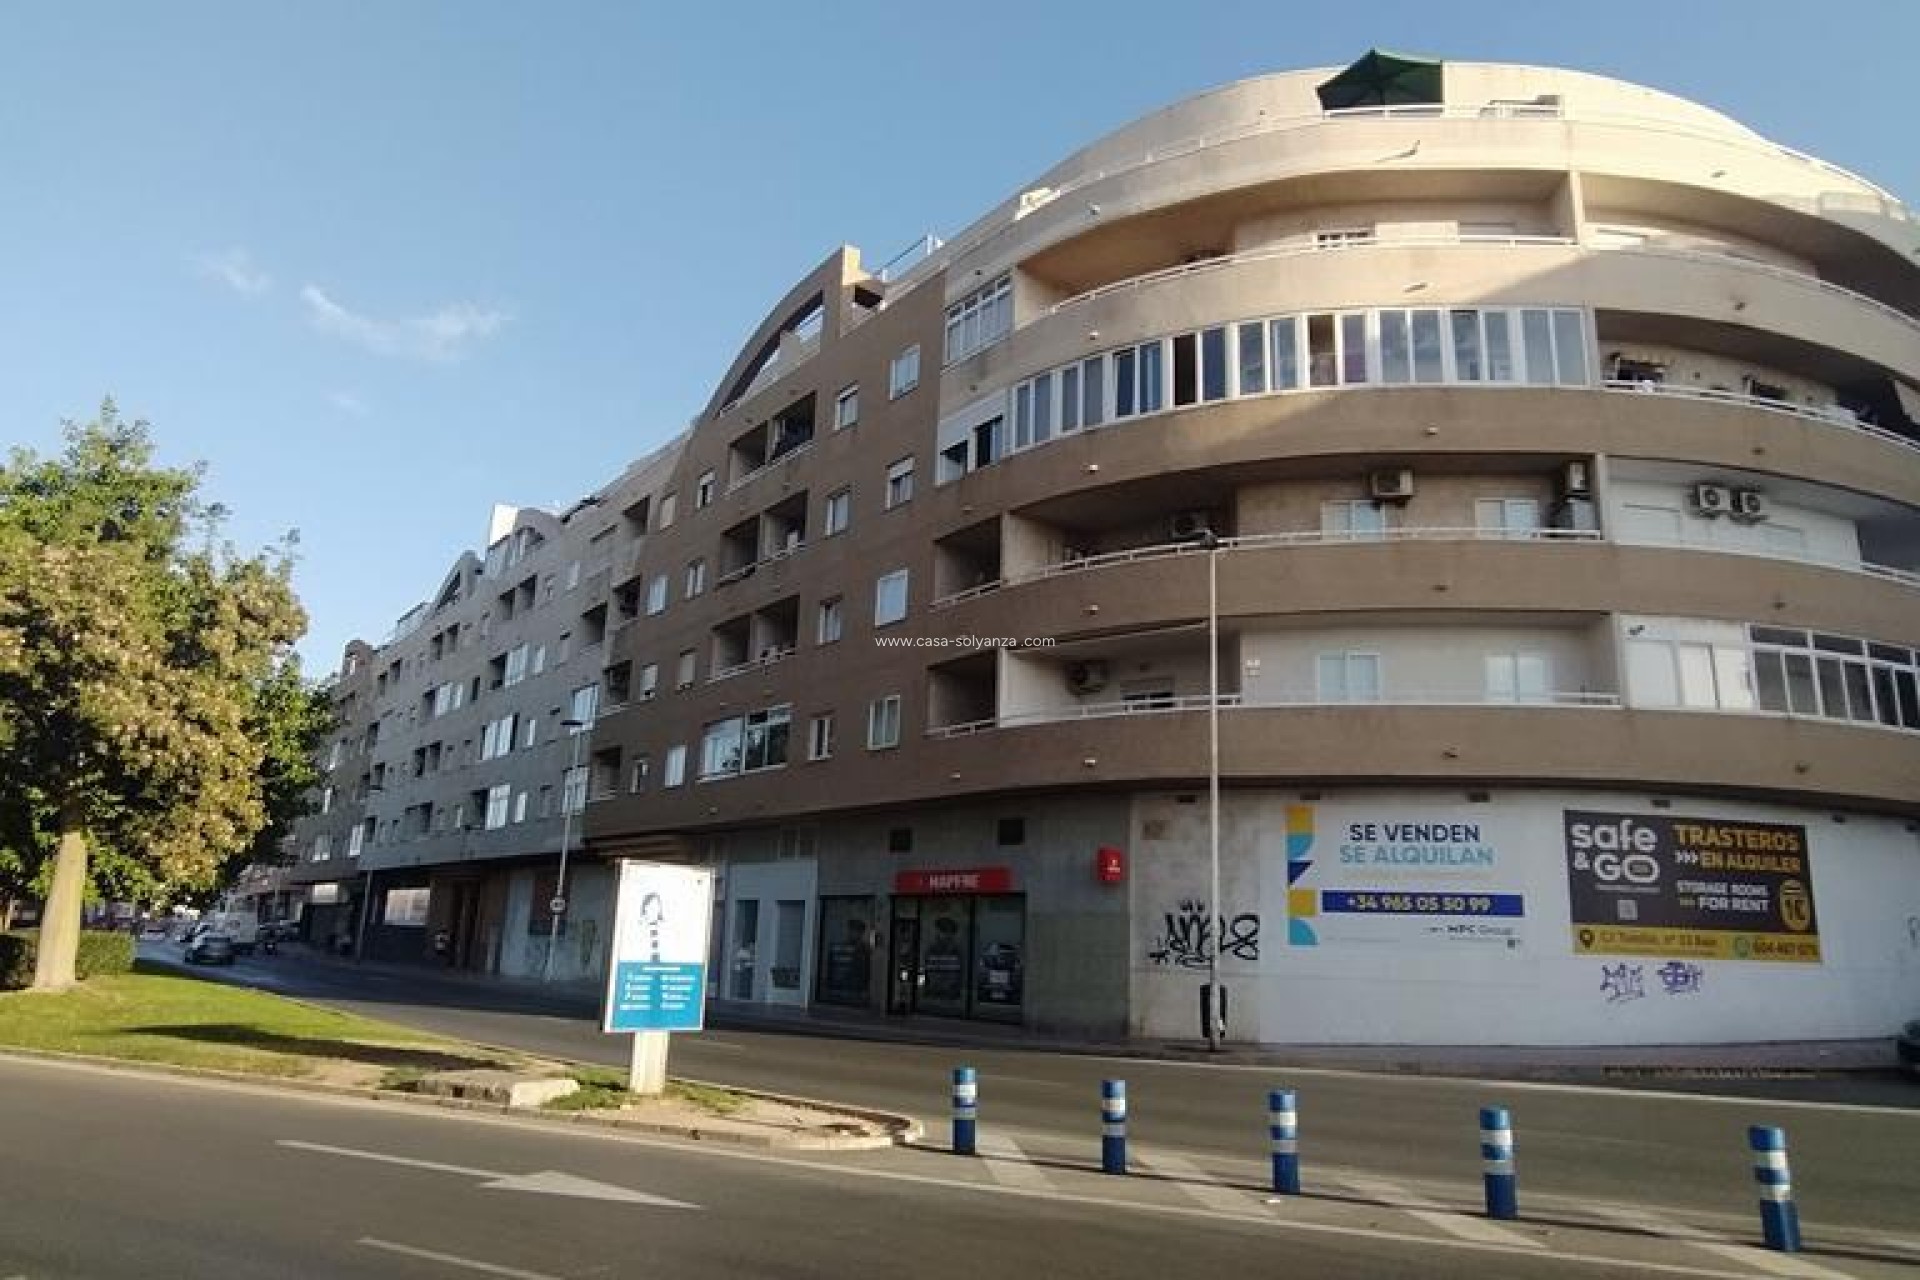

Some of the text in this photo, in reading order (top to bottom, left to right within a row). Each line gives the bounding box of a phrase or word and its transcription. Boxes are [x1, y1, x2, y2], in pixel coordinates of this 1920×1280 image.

[1349, 824, 1480, 843] SE VENDEN
[1570, 819, 1657, 851] safe
[1672, 824, 1801, 850] TRASTEROS
[1340, 844, 1494, 866] SE ALQUILAN
[1698, 850, 1801, 872] EN ALQUILER
[1574, 851, 1591, 870] &
[1594, 853, 1660, 883] GO
[929, 873, 981, 890] MAPFRE
[1347, 894, 1491, 912] +34 965 05 50 99
[1698, 896, 1769, 911] FOR RENT
